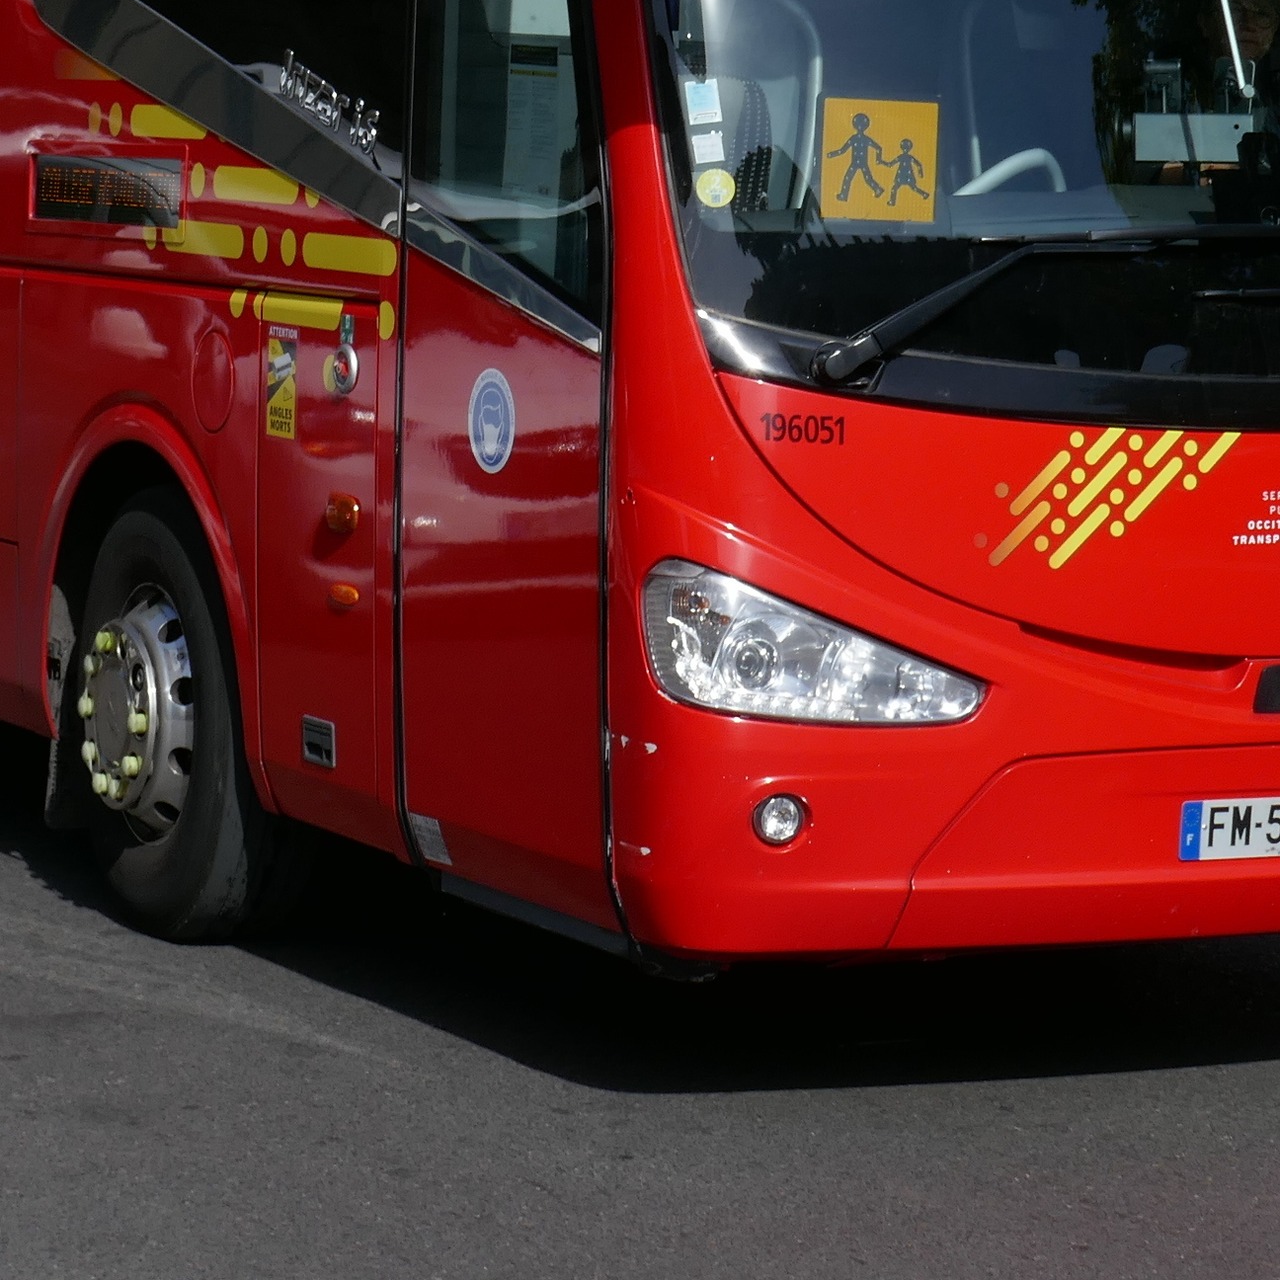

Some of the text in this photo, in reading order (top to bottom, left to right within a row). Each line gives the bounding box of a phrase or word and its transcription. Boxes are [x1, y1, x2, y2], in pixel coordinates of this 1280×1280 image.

[268, 326, 298, 340] ATTENTION
[269, 405, 293, 421] ANGLES
[270, 419, 291, 433] MORTS
[760, 412, 845, 446] 196051
[1186, 833, 1194, 846] F
